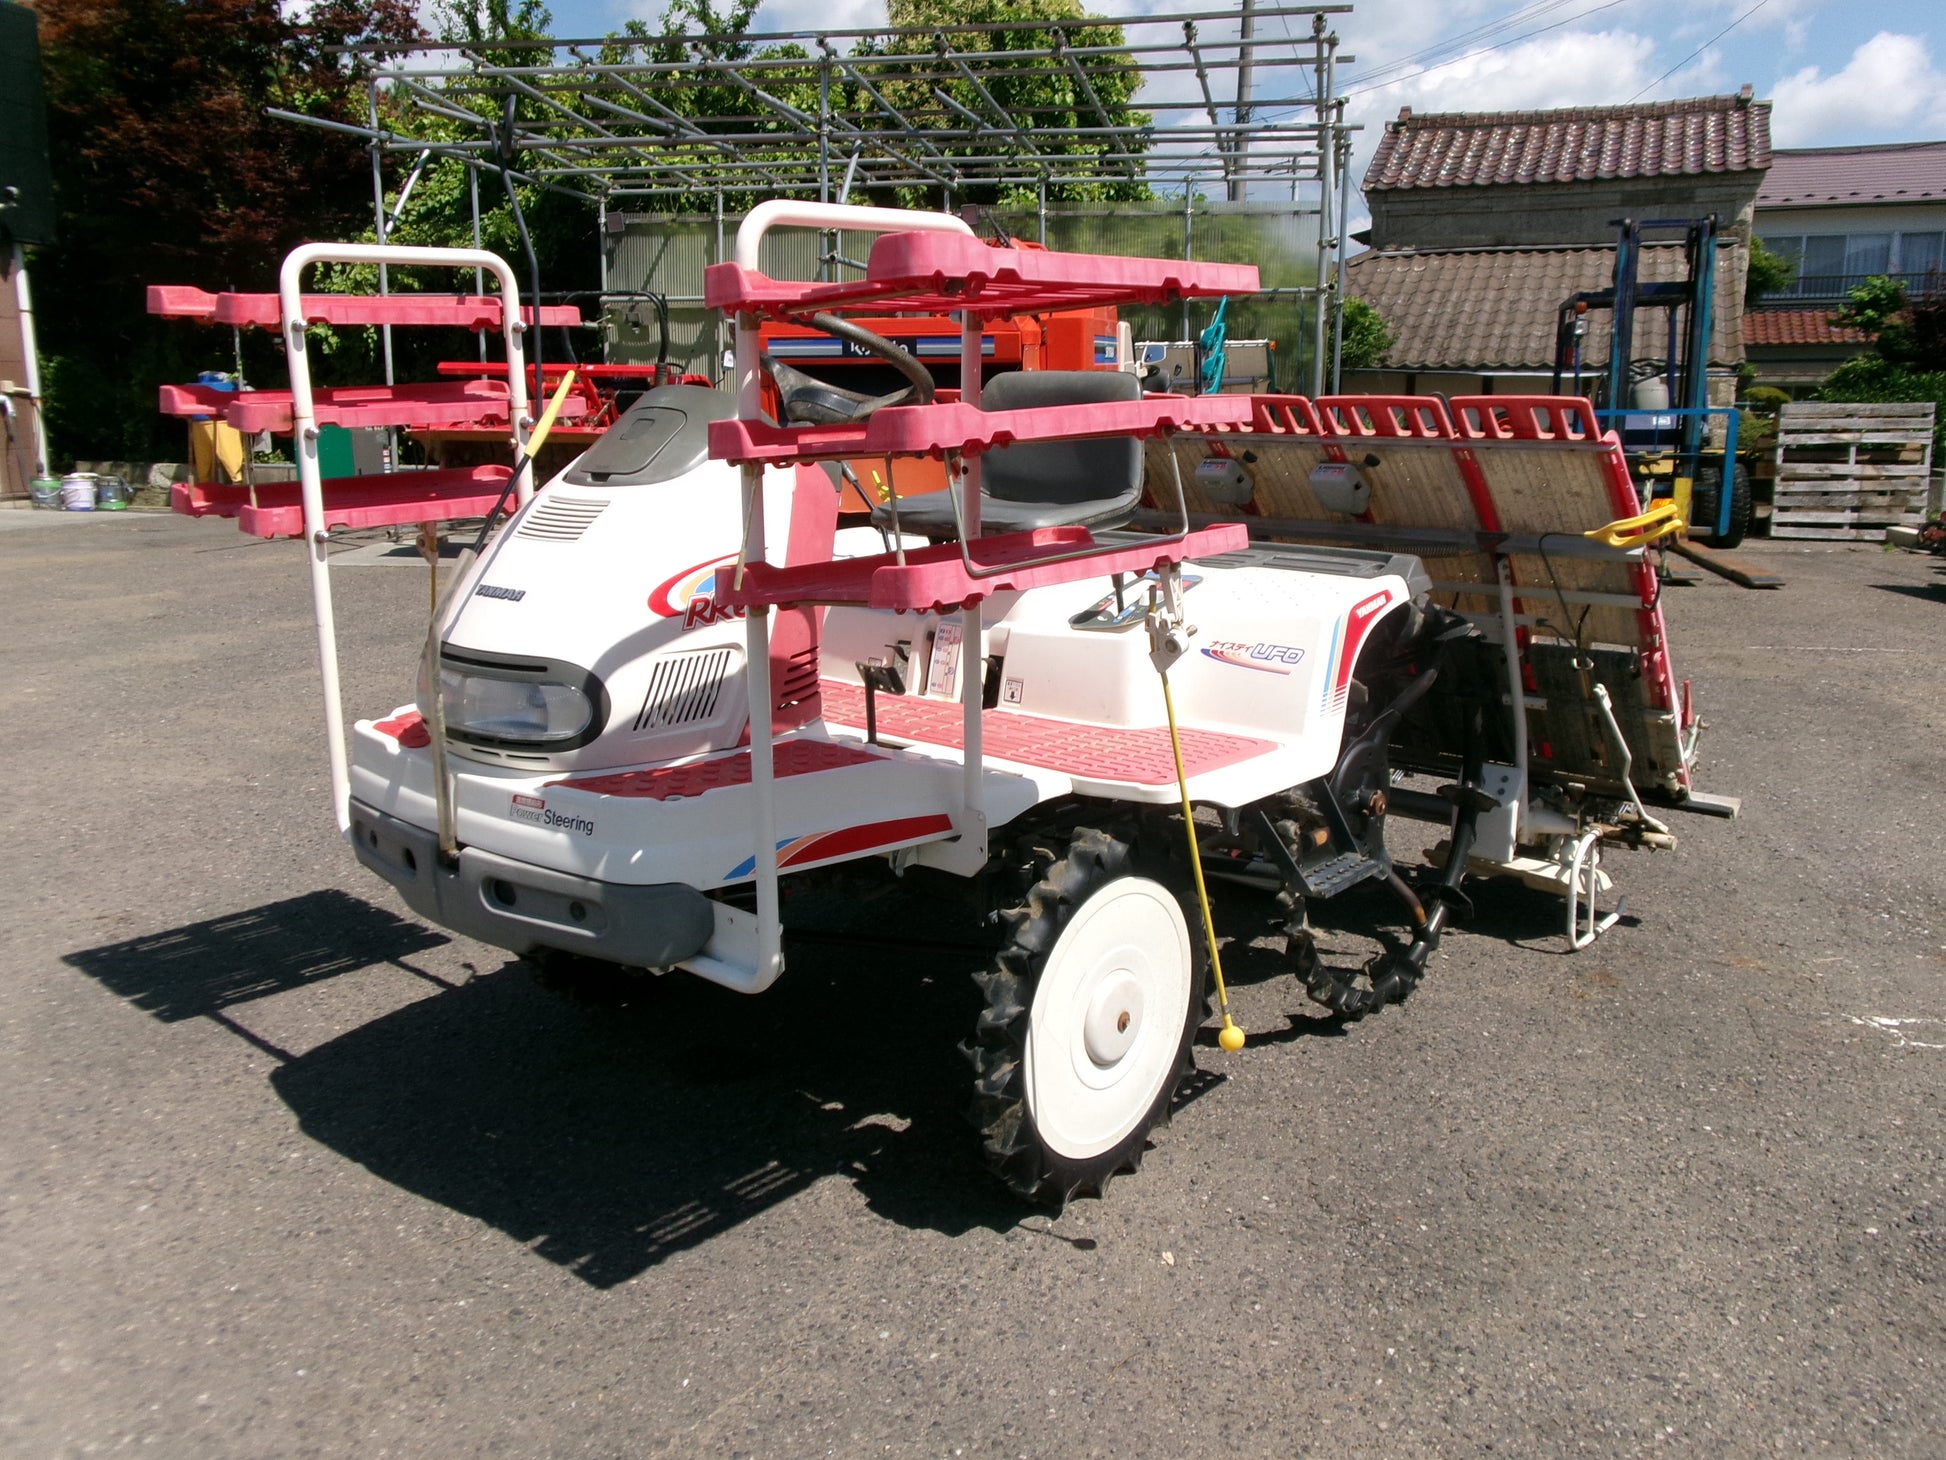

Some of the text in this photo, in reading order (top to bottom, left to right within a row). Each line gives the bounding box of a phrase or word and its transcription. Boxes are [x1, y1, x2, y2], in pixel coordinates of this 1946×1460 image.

[1209, 640, 1305, 664] ナイスティ UFO
[509, 803, 594, 836] Power Steering
